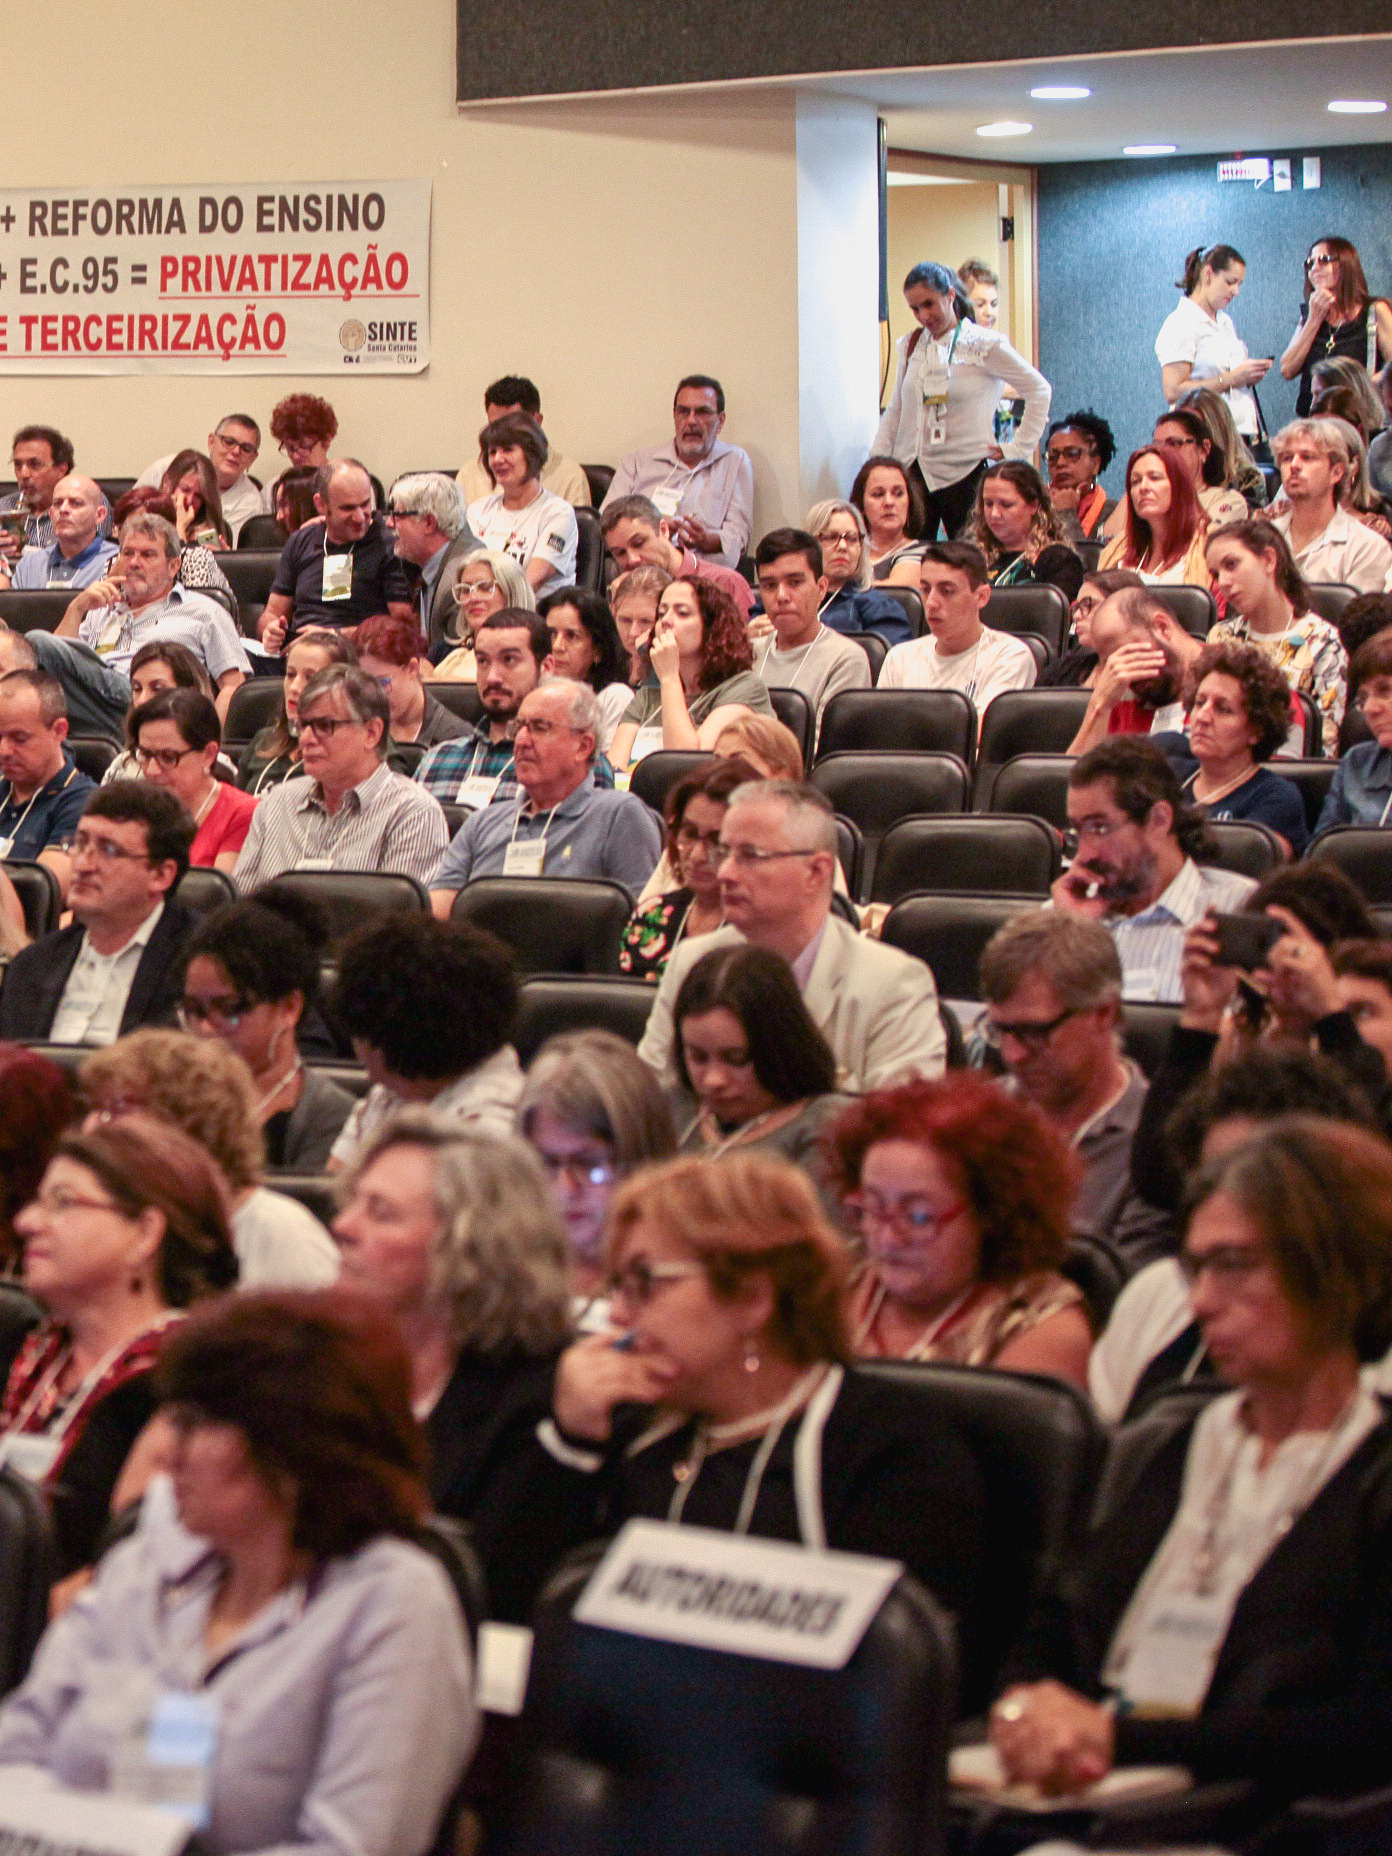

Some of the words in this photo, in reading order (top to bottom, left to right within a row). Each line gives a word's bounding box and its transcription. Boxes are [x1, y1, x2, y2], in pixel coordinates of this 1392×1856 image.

[28, 197, 187, 237] REFORMA
[199, 196, 244, 234] DO
[256, 192, 386, 233] ENSINO
[19, 256, 119, 295] E.C.95
[159, 244, 410, 302] PRIVATIZAÇÃO
[20, 304, 287, 361] TERCEIRIZAÇÃO
[367, 321, 418, 343] SINTE
